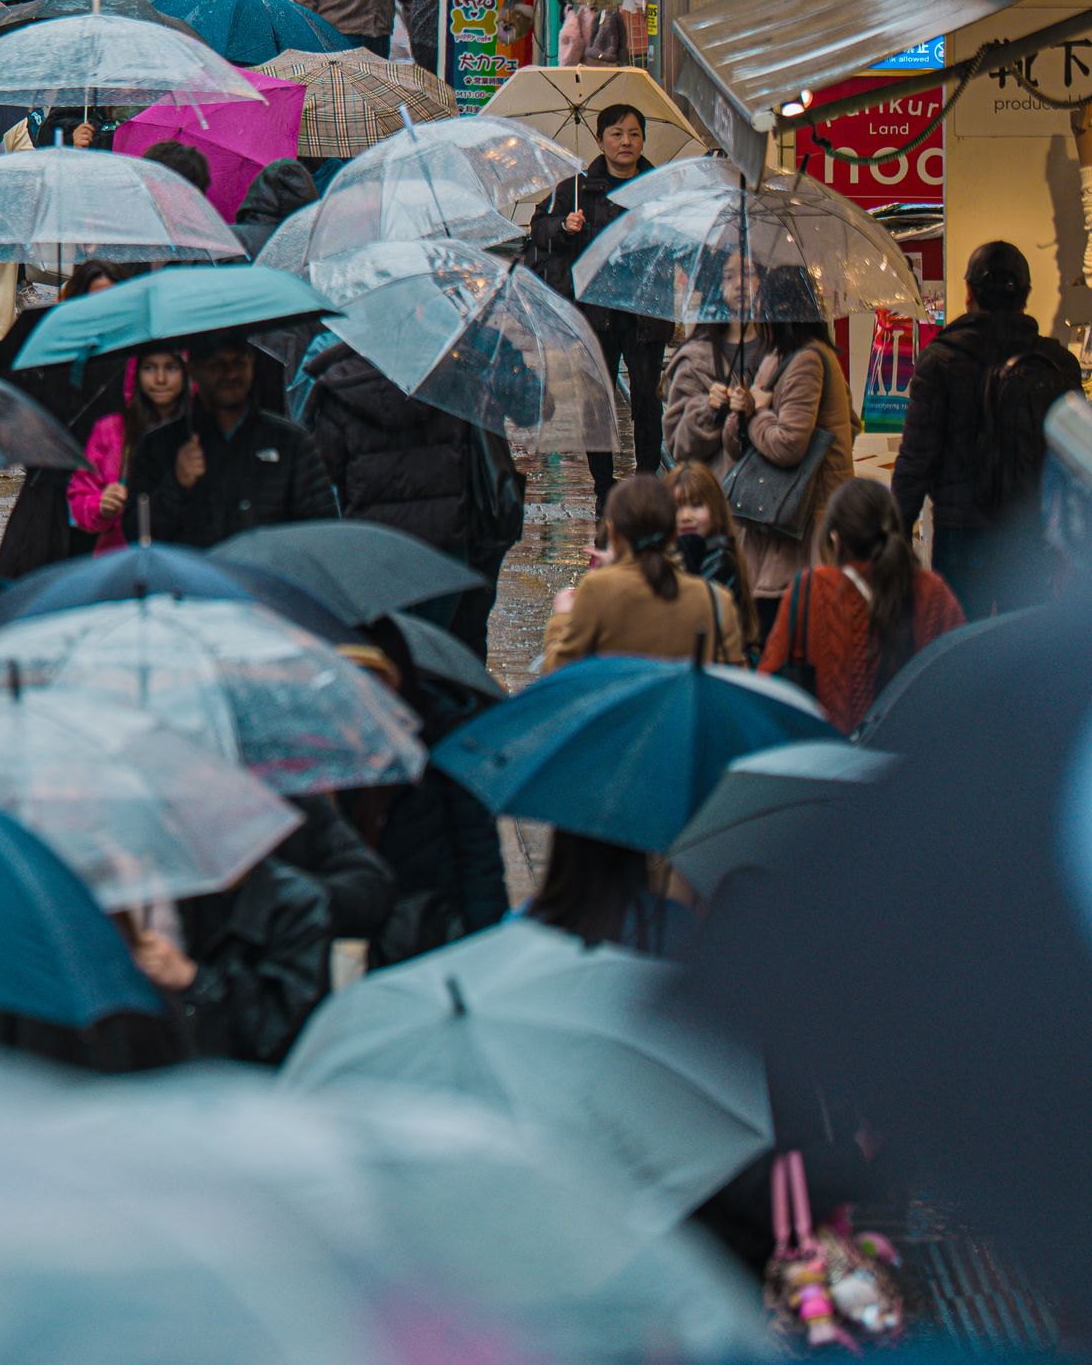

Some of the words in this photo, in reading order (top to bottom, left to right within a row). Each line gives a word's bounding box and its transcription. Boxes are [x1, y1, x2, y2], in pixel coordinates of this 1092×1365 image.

[458, 52, 519, 72] 犬カフェ
[898, 55, 930, 64] allowed
[869, 123, 910, 135] Land
